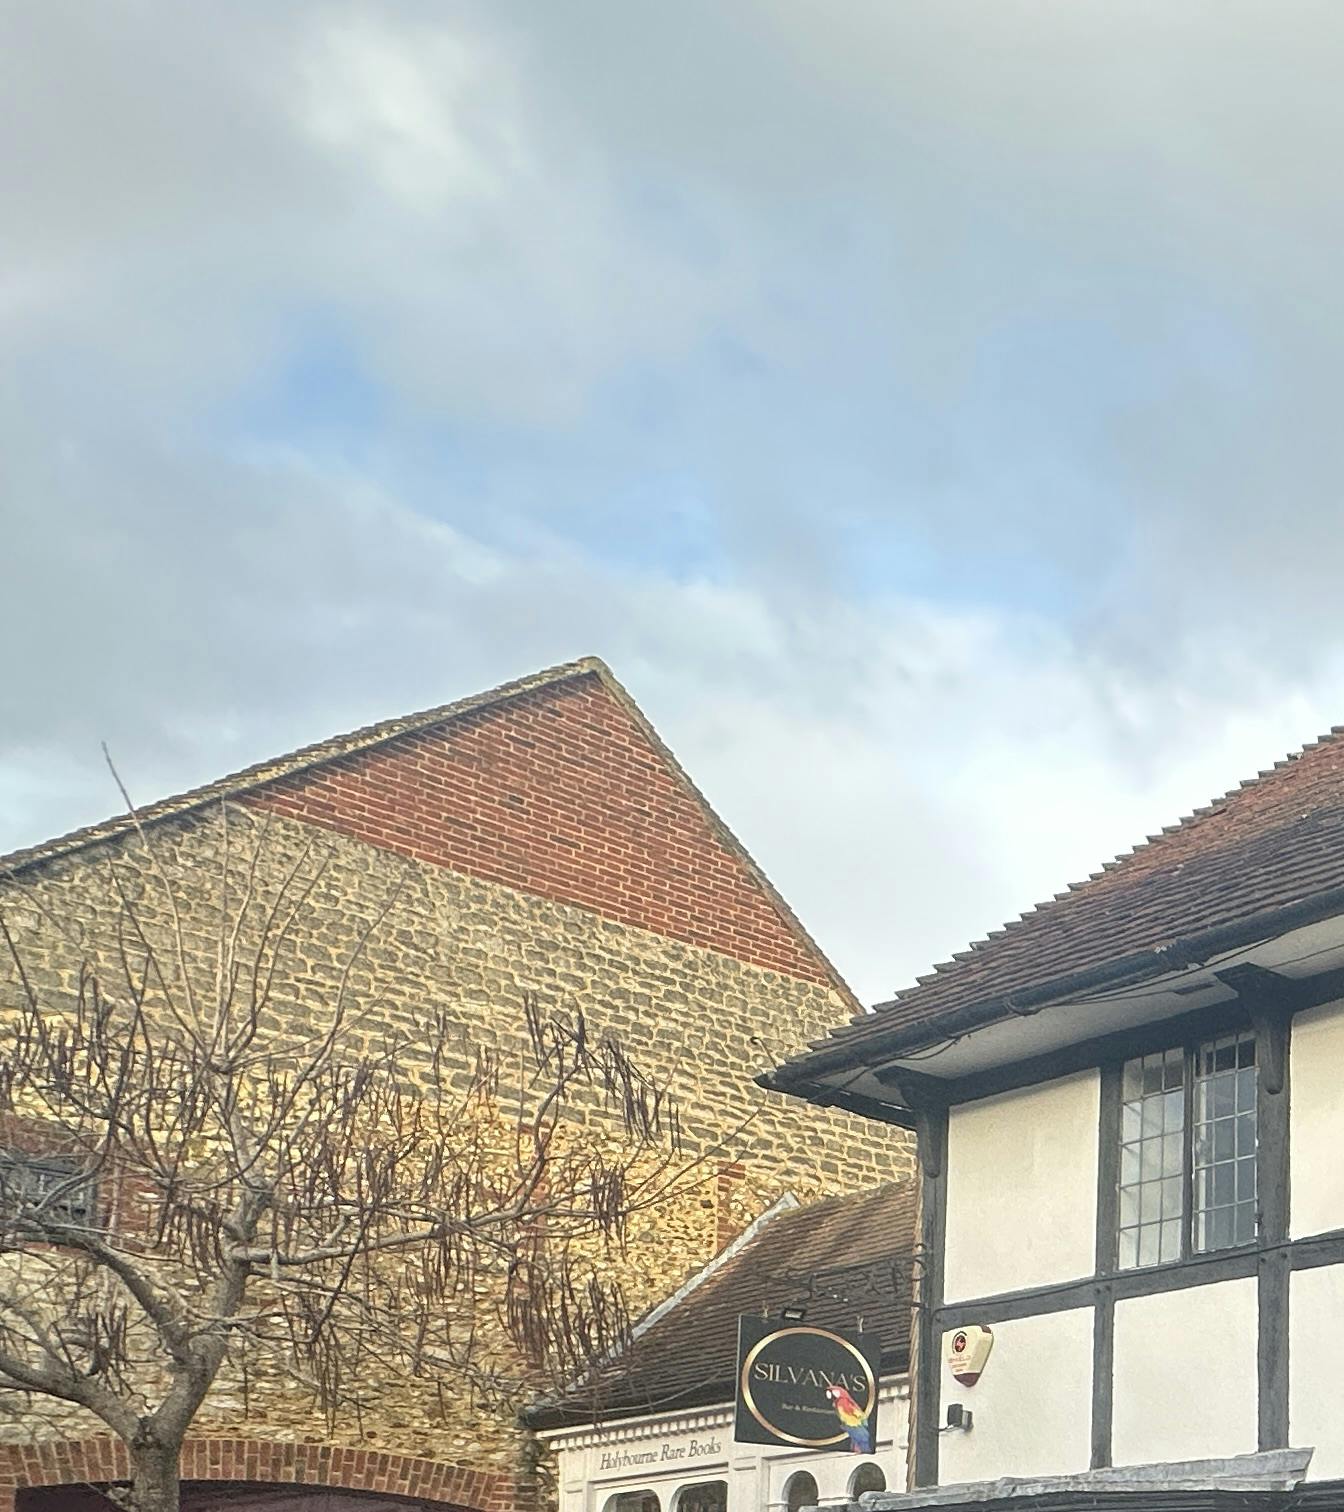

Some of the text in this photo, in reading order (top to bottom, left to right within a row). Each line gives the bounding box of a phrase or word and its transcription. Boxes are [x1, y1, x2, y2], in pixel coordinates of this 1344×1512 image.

[754, 1362, 866, 1392] SILVANA'S
[600, 1436, 721, 1471] Holybourne Rare Books
